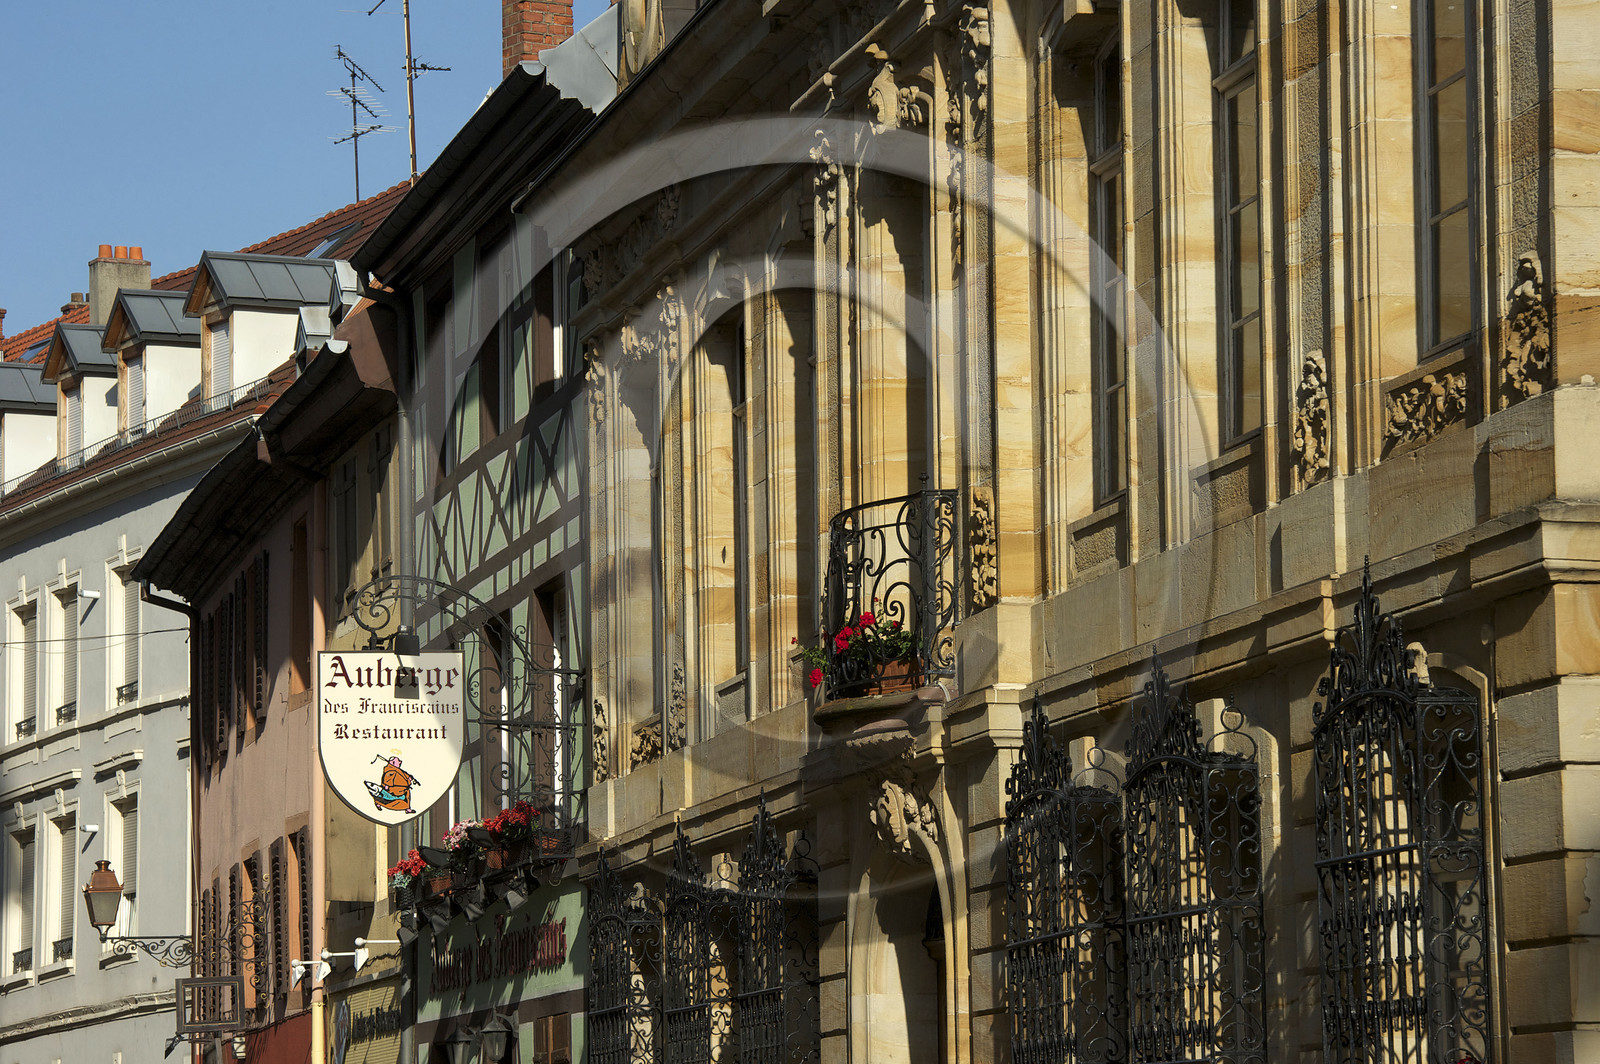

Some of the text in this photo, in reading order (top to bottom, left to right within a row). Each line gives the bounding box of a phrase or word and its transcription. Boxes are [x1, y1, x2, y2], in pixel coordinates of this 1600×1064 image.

[324, 655, 460, 696] Auberge
[324, 697, 460, 714] des Franciscains
[333, 723, 448, 740] Restaurant
